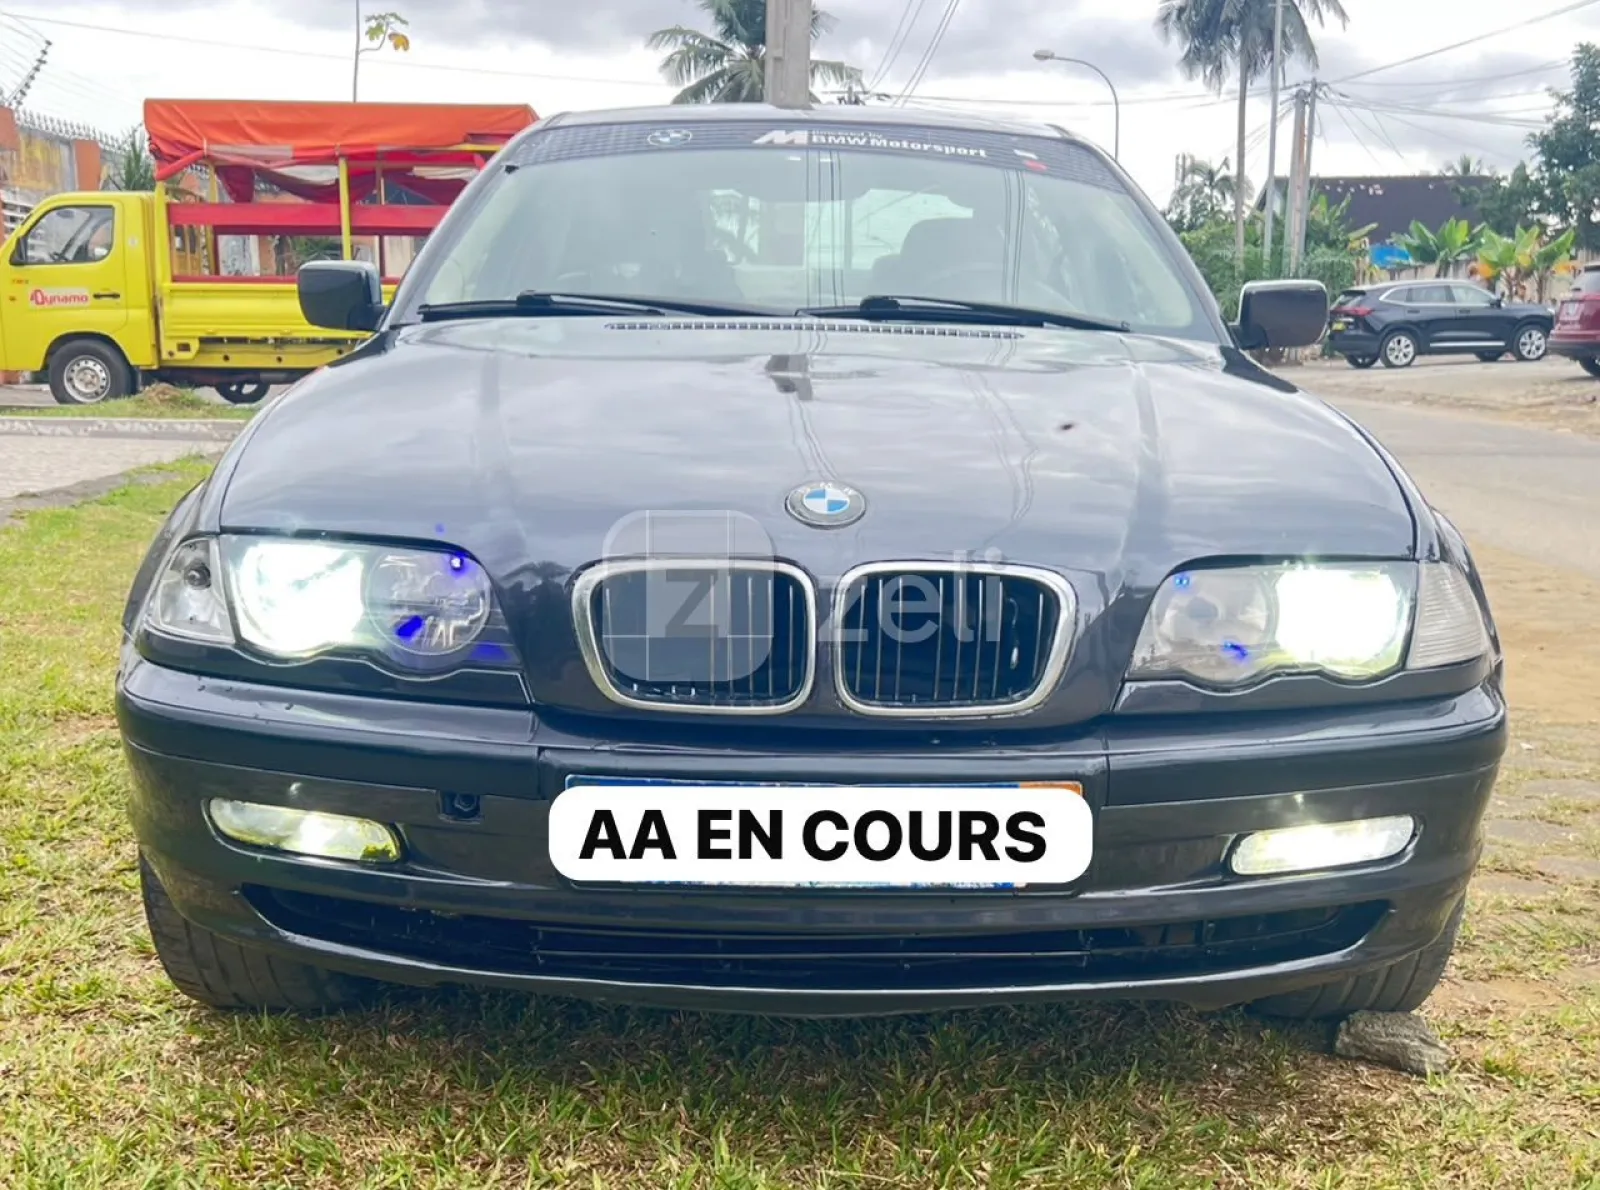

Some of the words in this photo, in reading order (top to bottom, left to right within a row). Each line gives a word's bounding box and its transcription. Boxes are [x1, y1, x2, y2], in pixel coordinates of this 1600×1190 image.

[812, 134, 868, 146] BMW
[869, 136, 988, 158] Motorsport
[33, 289, 89, 306] Dynamo
